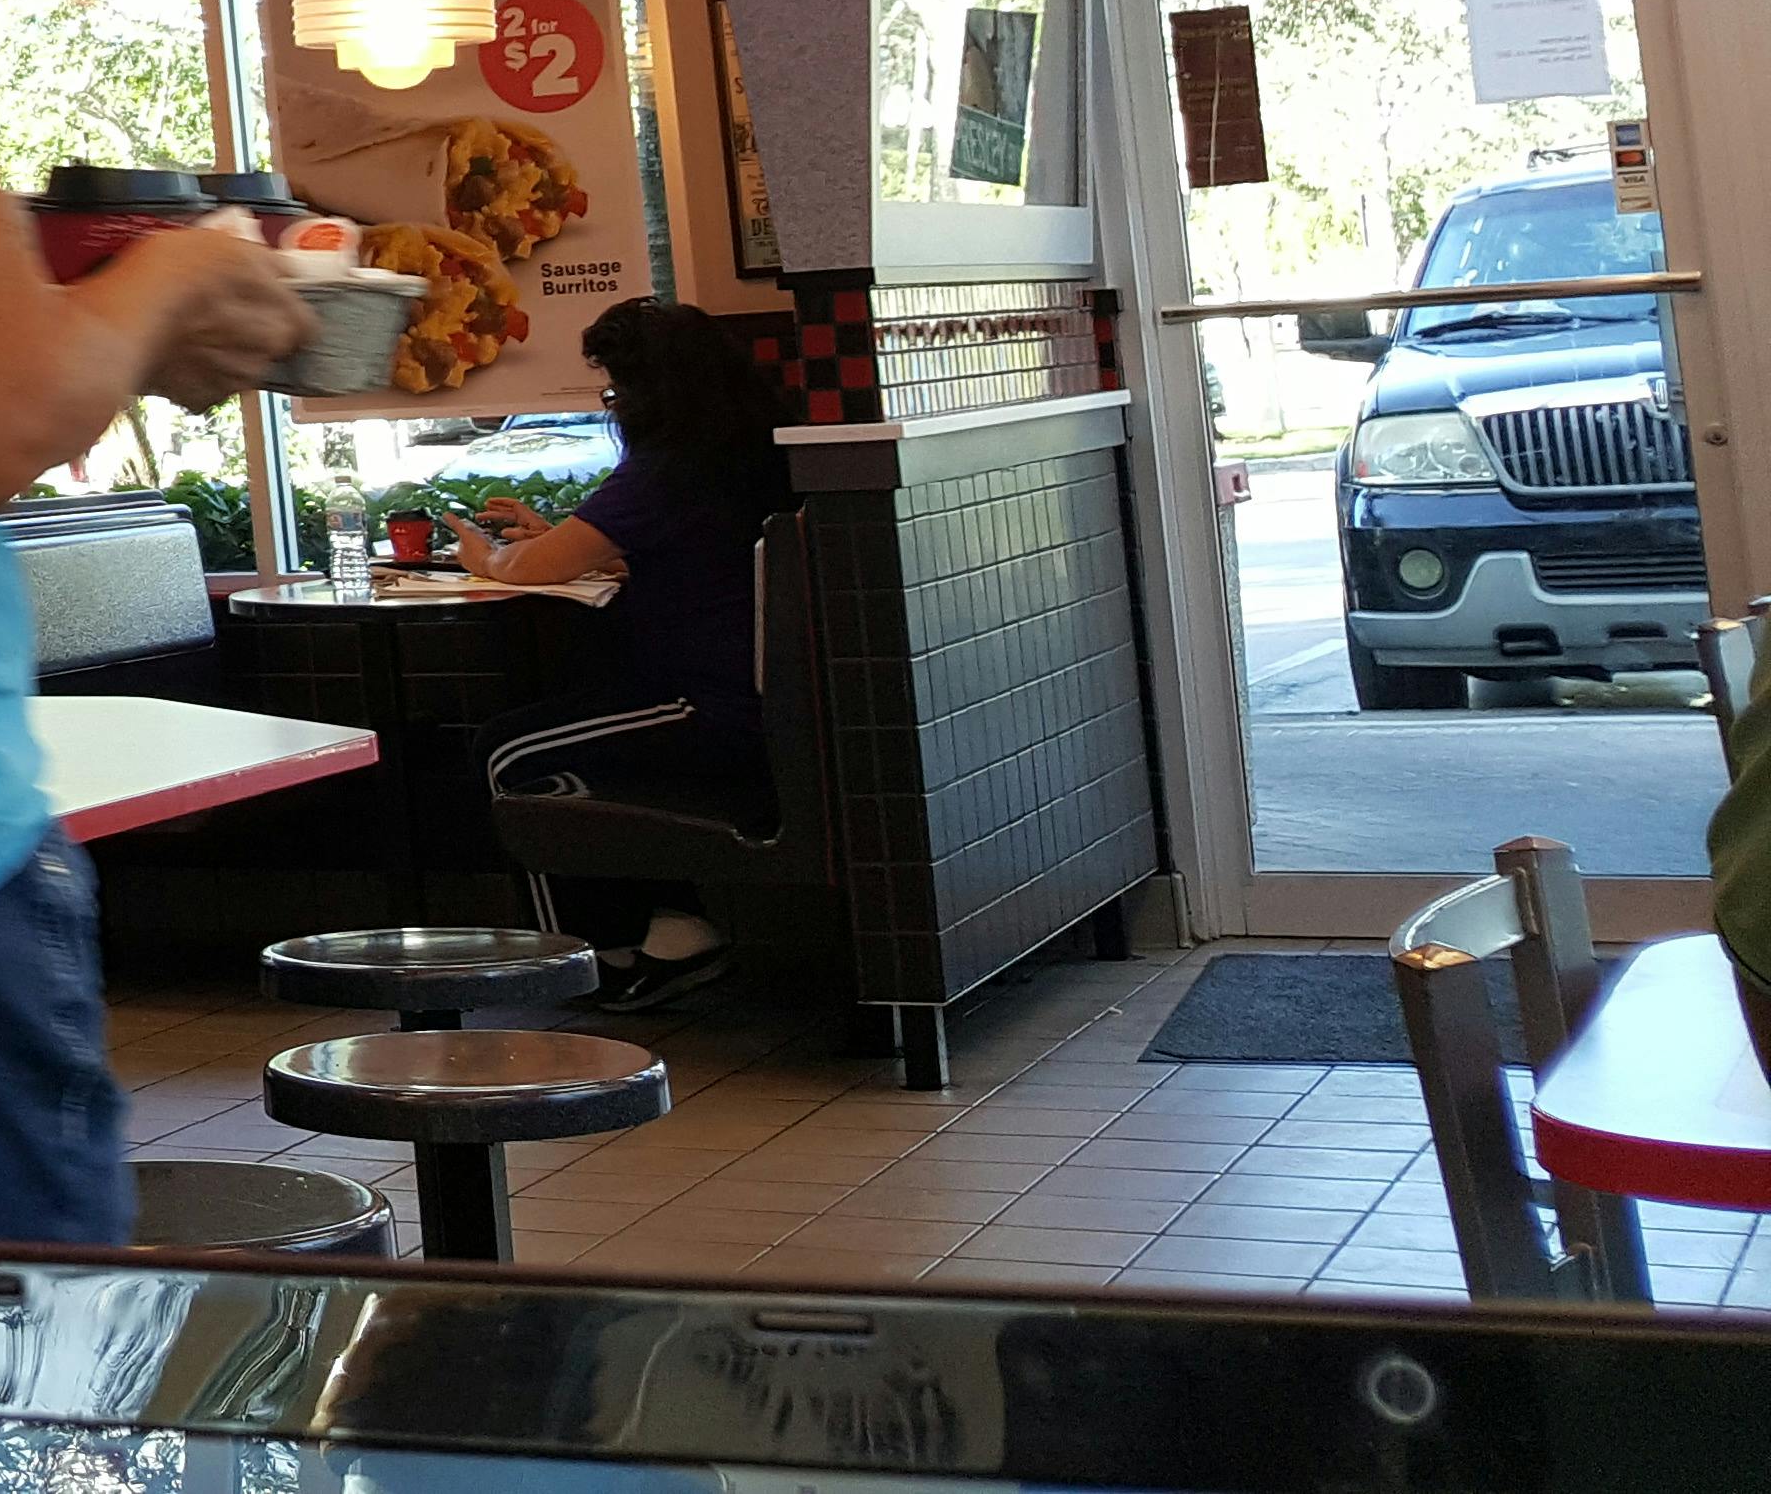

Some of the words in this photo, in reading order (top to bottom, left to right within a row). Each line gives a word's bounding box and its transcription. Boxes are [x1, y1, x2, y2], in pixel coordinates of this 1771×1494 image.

[502, 7, 526, 38] 2
[531, 18, 558, 35] for
[504, 33, 580, 97] $2
[541, 258, 622, 281] Sausage
[542, 277, 618, 296] Burritos
